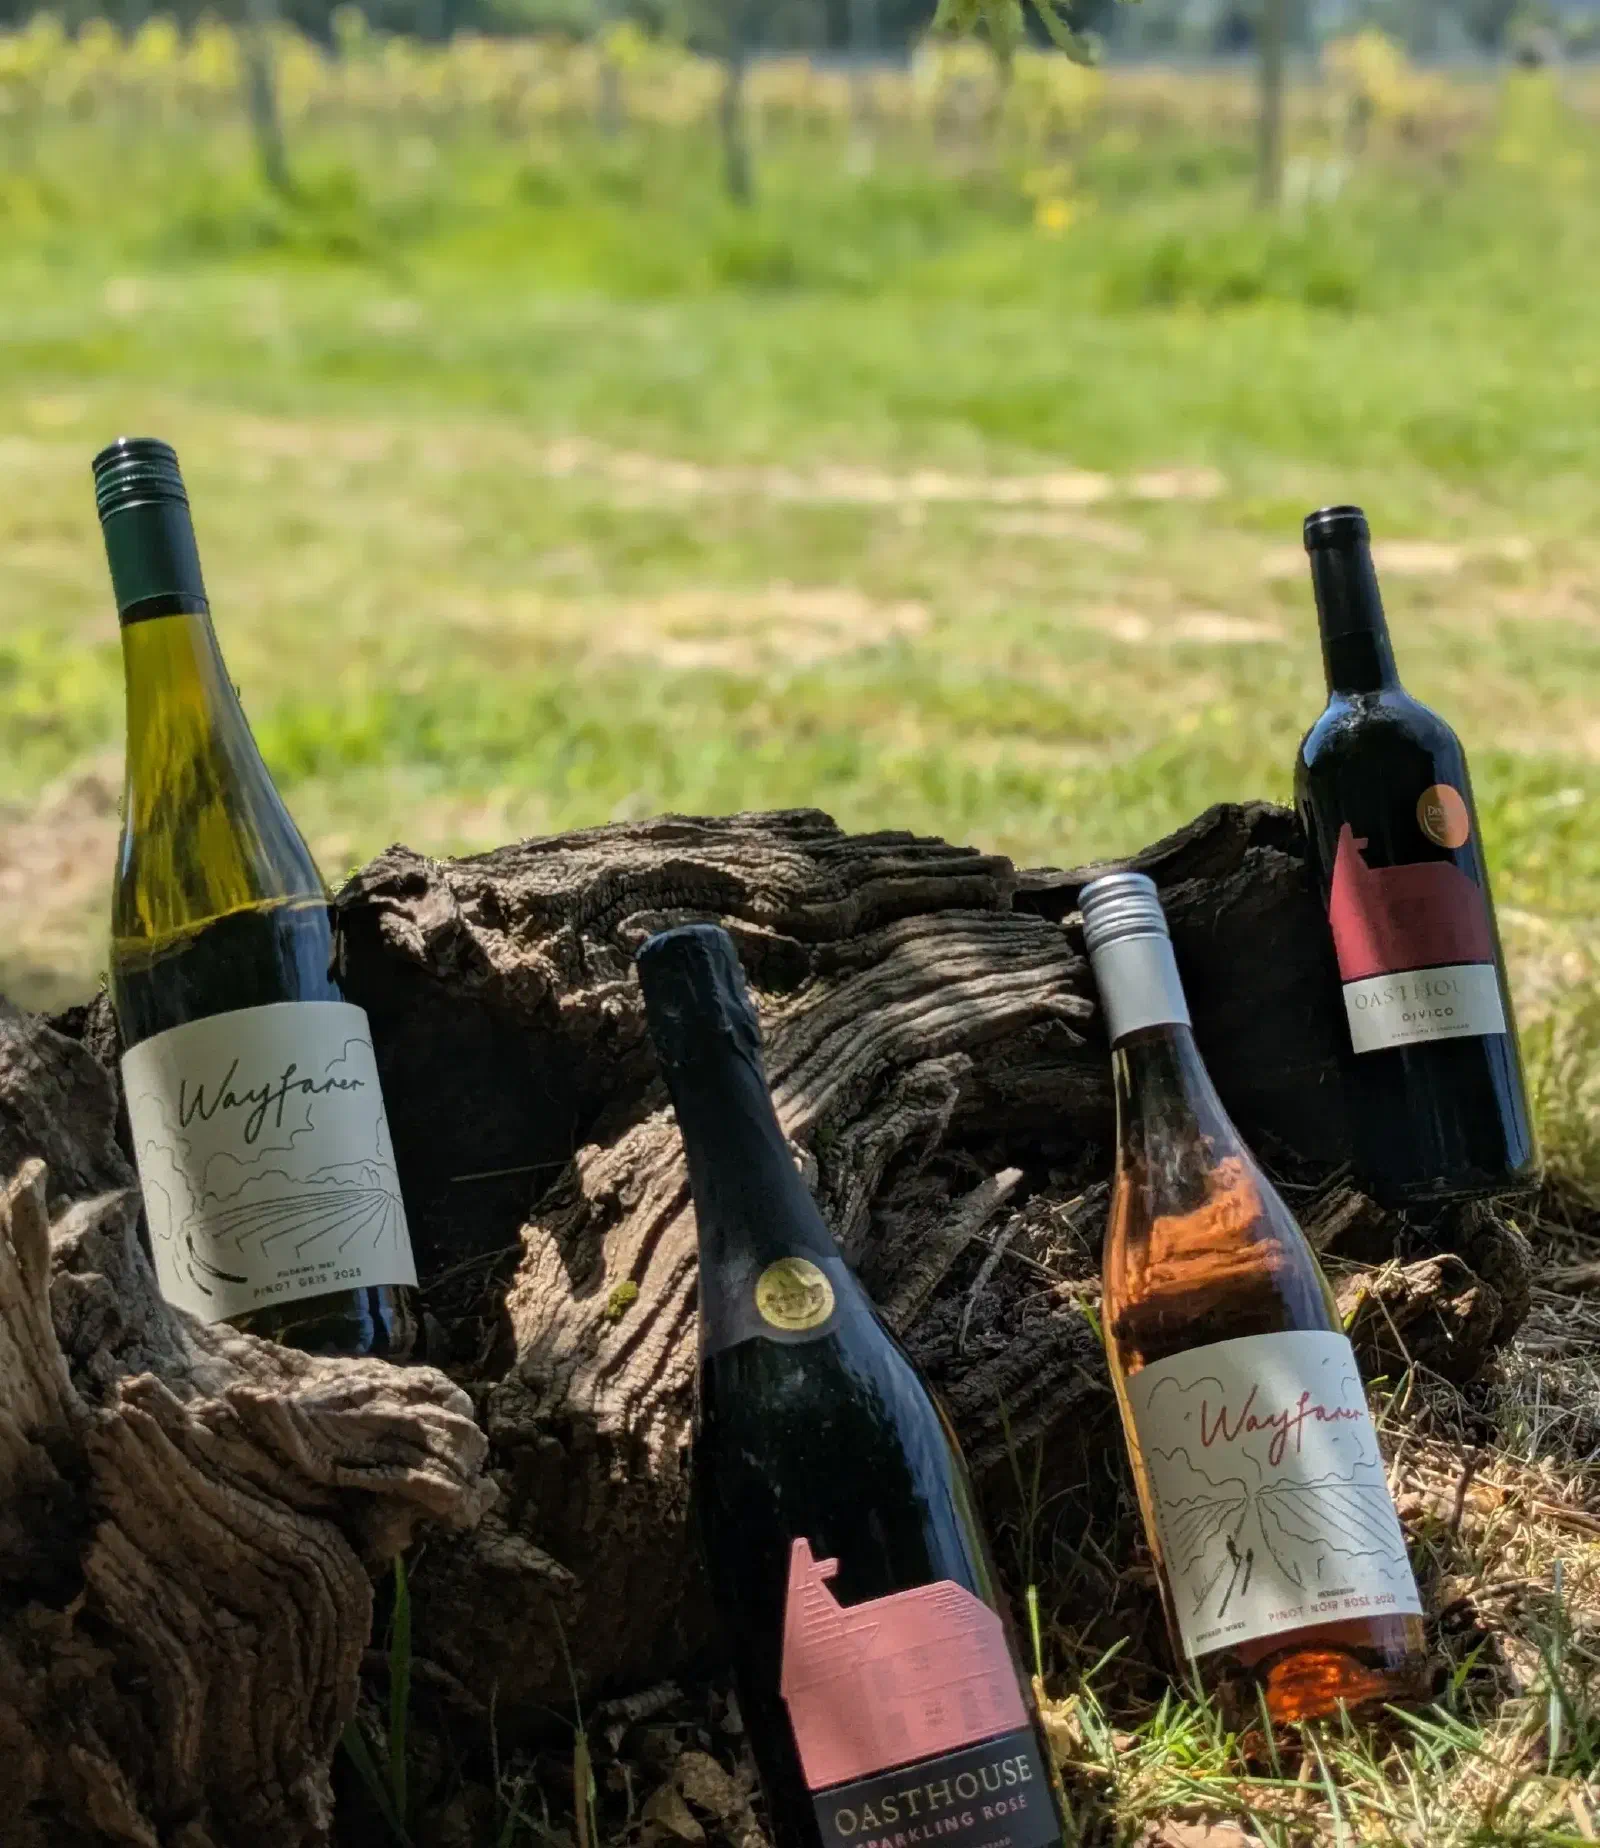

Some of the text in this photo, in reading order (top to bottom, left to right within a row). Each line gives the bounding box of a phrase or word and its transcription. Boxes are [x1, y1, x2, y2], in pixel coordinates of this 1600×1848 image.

[1401, 1006, 1454, 1022] DIVICO
[178, 1058, 365, 1145] Wayfarer
[253, 1280, 291, 1299] PINOT
[1200, 1383, 1363, 1467] Wayfarer
[834, 1754, 1034, 1837] OASTHOUSE
